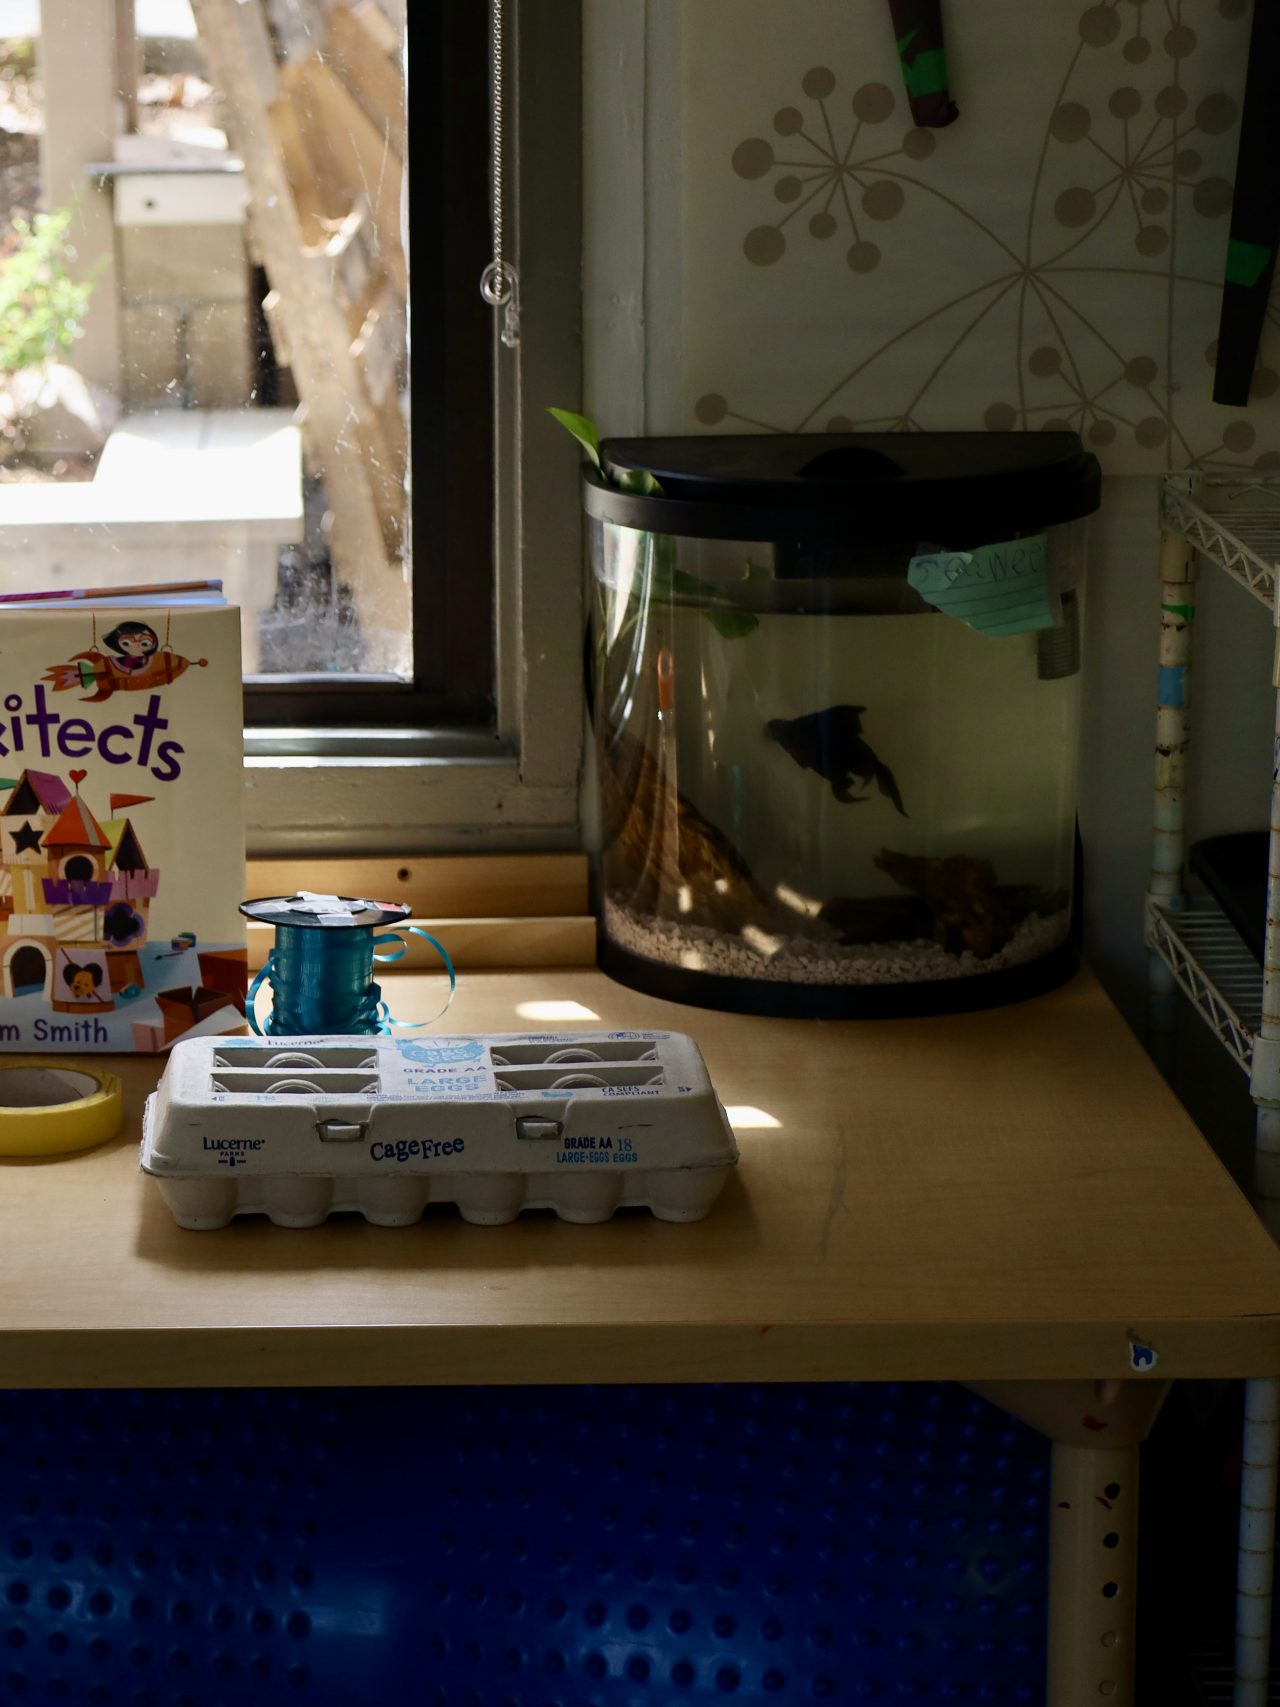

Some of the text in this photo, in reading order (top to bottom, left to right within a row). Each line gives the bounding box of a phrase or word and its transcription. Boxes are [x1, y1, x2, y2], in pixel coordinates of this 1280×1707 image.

[33, 1018, 109, 1044] Smith
[407, 1075, 487, 1085] LARGE
[415, 1084, 480, 1092] EGGS
[203, 1137, 265, 1151] Lucerne
[370, 1137, 465, 1163] Cage Free
[564, 1136, 633, 1152] GRADE AA 18
[613, 1153, 638, 1163] EGGS
